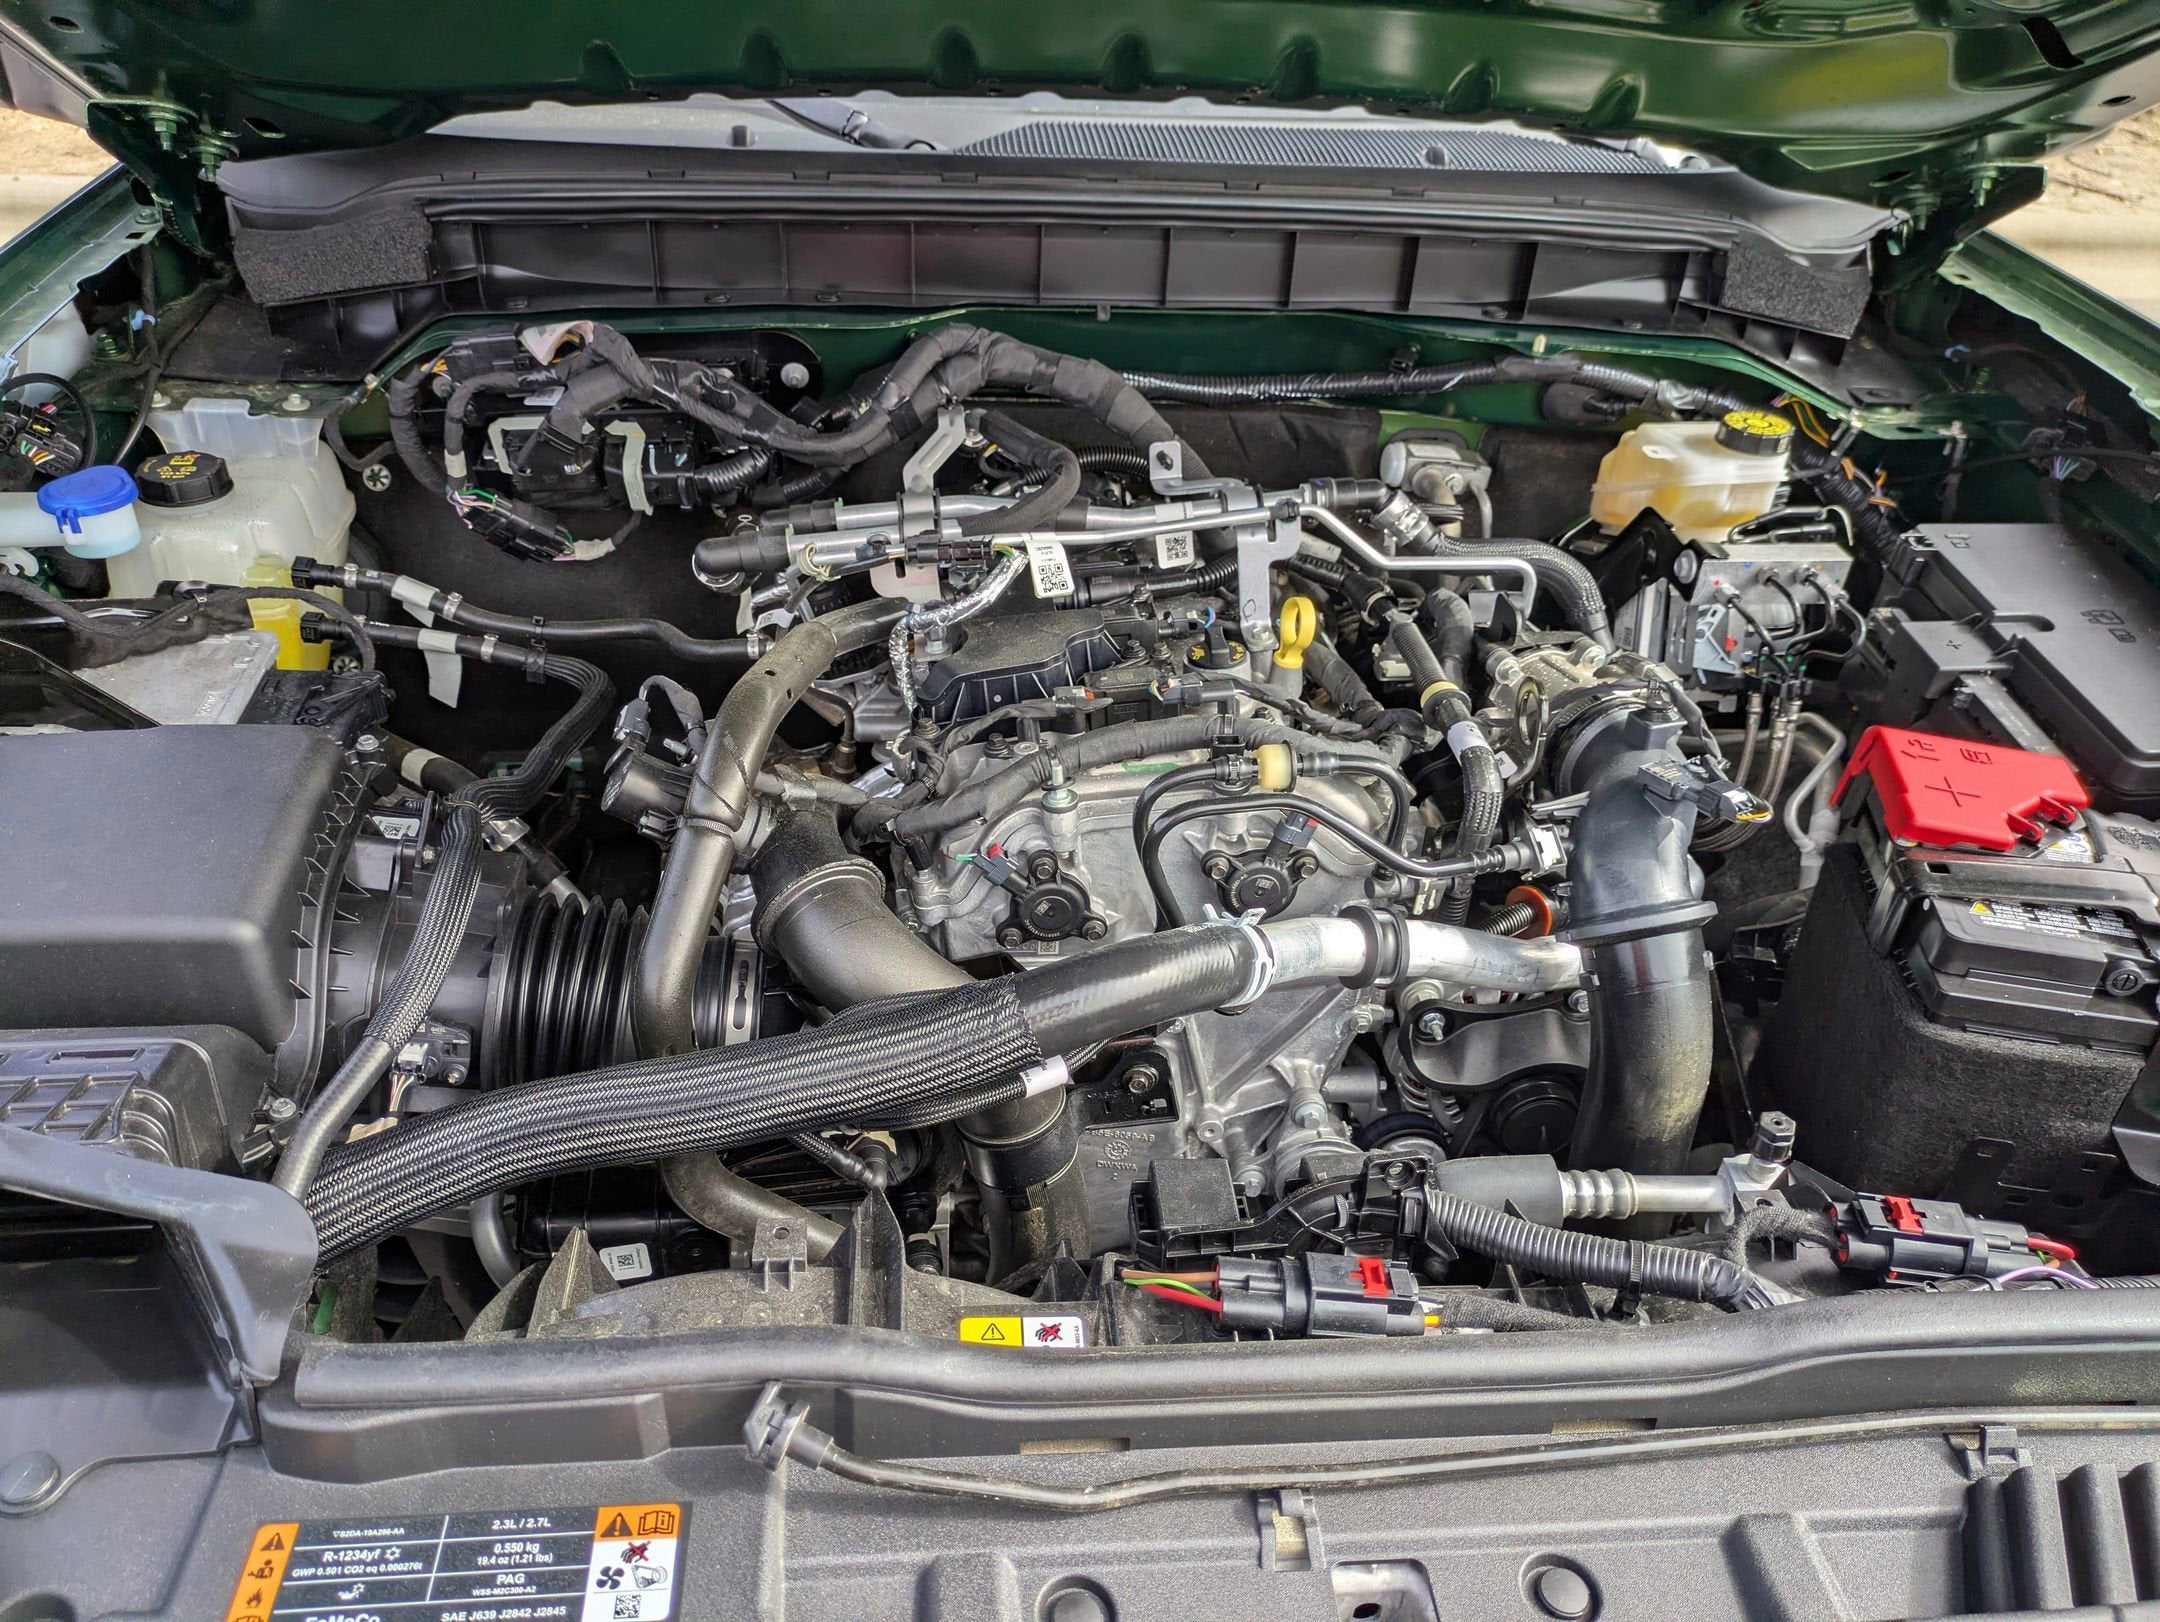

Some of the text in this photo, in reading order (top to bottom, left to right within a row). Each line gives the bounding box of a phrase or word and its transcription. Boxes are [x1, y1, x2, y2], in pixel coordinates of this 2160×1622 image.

[491, 1519, 515, 1530] 2.3L
[526, 1518, 551, 1528] 2.7L
[494, 1542, 540, 1554] 0.550 kg
[322, 1549, 381, 1563] R-1234yf
[477, 1553, 553, 1567] 19.4 oz (1.21 lbs)
[292, 1567, 316, 1578] GWP
[317, 1565, 342, 1576] 0.501
[343, 1565, 364, 1575] CO2
[365, 1565, 378, 1576] eq
[496, 1573, 525, 1585] PAG
[441, 1606, 567, 1622] SAE J639 J2842 J2845
